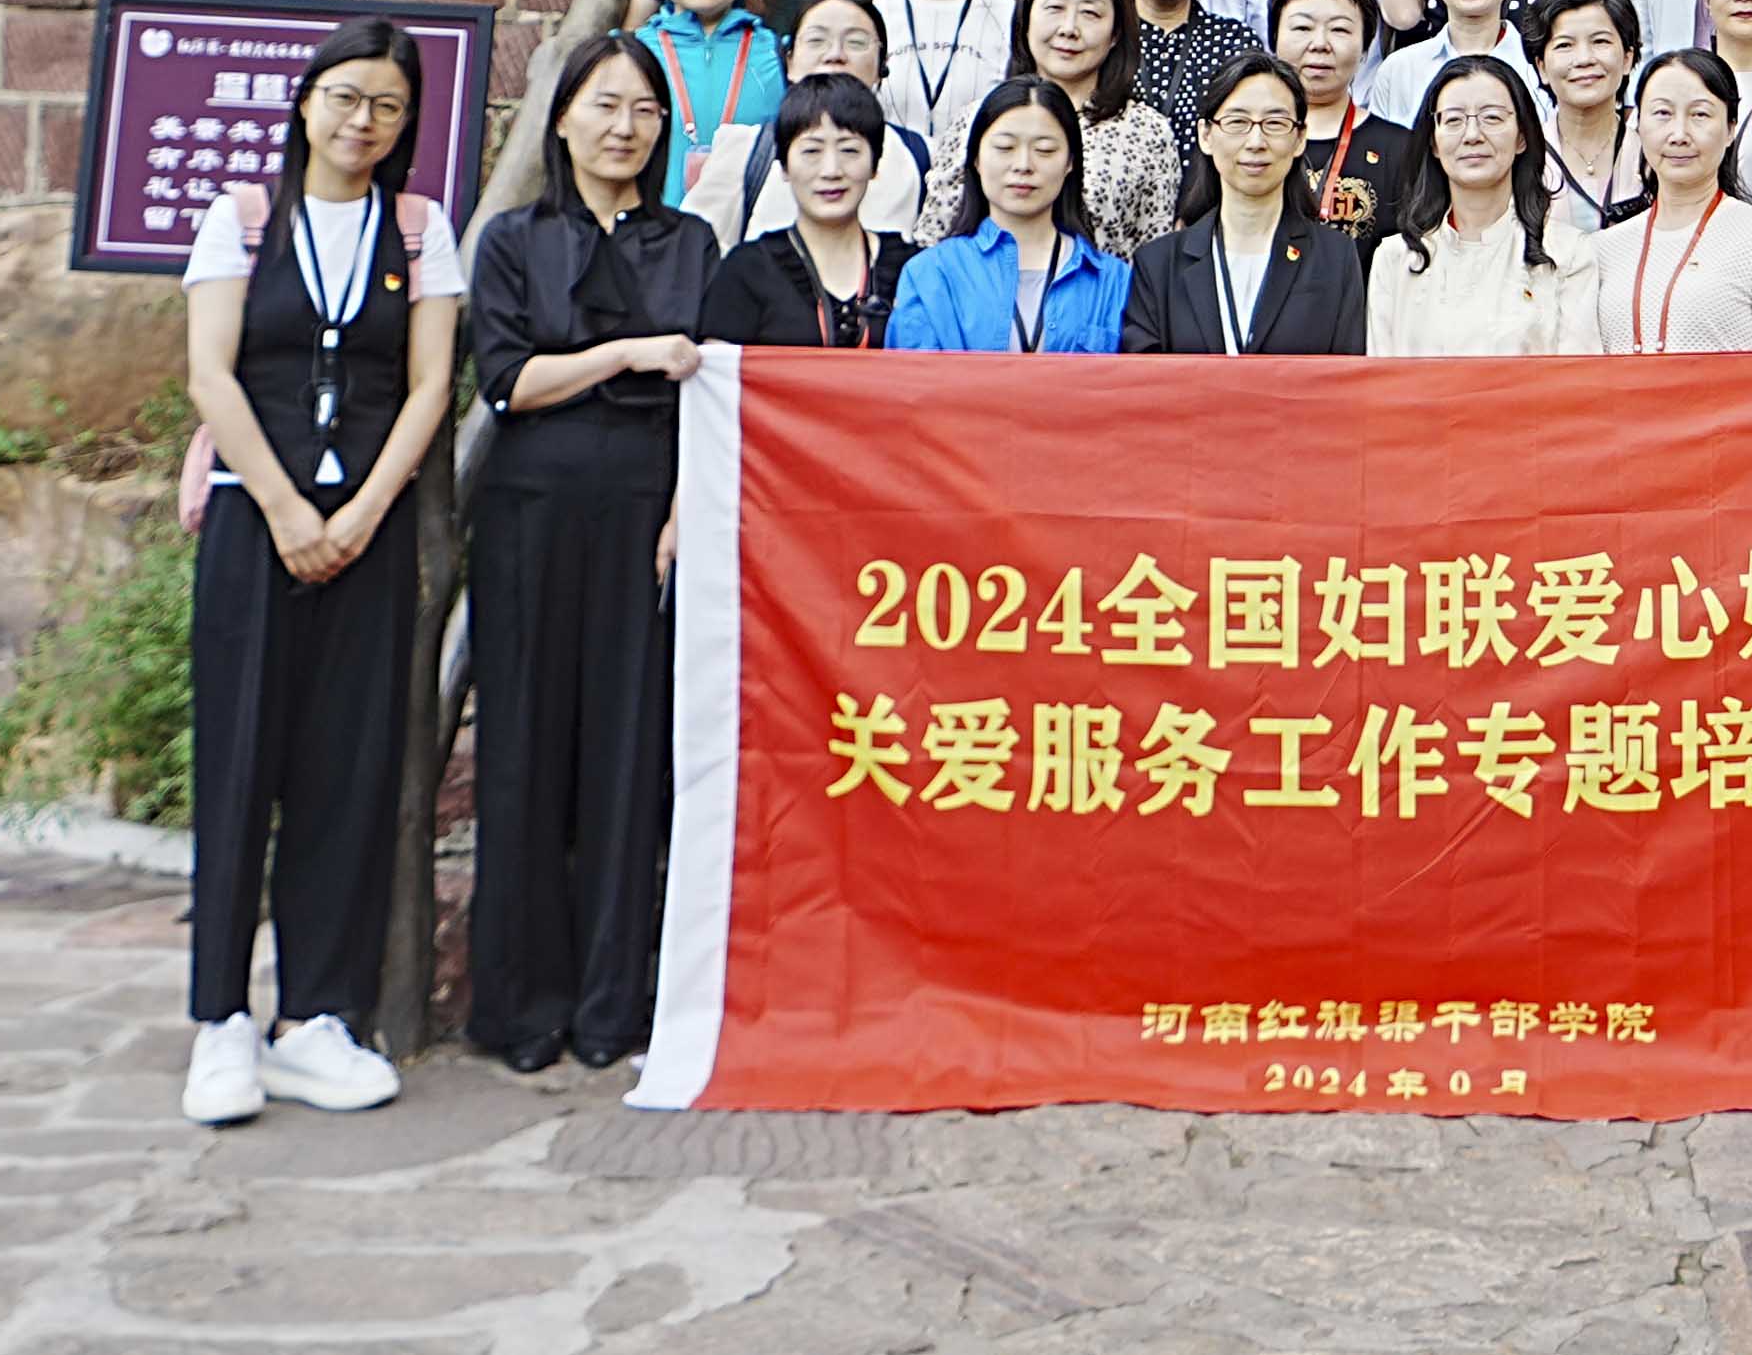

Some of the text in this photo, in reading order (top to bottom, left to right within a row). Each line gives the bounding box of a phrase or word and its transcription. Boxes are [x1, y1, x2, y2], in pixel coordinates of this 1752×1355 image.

[1140, 999, 1658, 1045] 河南红旗渠干部学院
